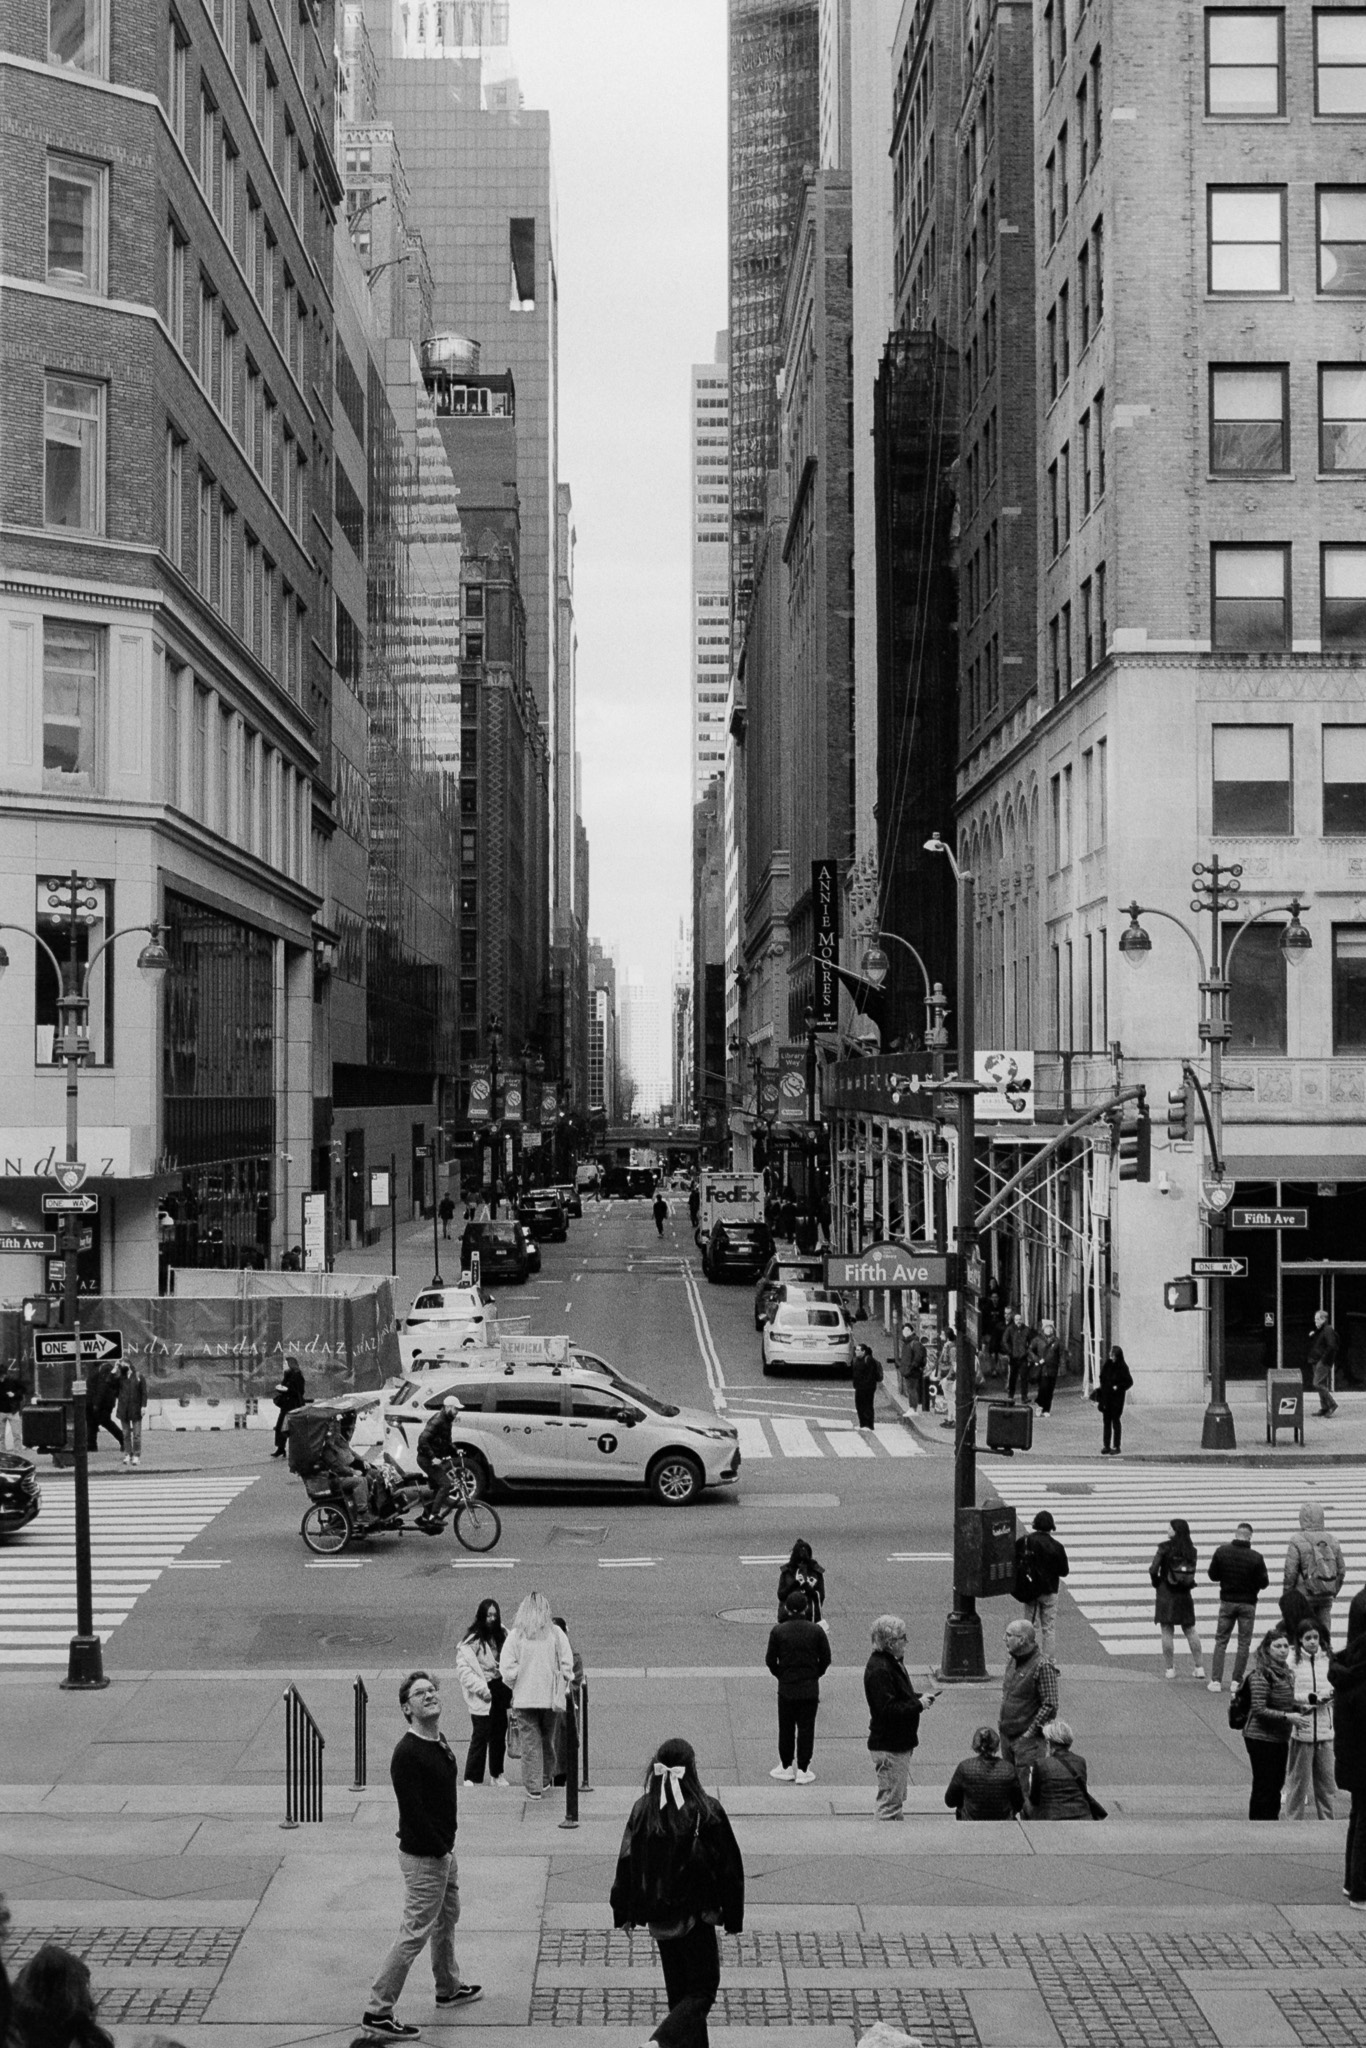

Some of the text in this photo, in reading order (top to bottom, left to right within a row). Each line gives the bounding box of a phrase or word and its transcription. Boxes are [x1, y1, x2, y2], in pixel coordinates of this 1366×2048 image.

[817, 865, 832, 928] ANNIE
[817, 931, 836, 1006] MOORES
[780, 1052, 805, 1061] Library
[785, 1059, 801, 1067] Way
[705, 1185, 761, 1204] FedEx
[47, 1199, 91, 1208] ONE WAY
[1244, 1213, 1296, 1224] Fifth Ave
[23, 1239, 44, 1249] Ave
[845, 1263, 929, 1281] Fifth Ave
[1199, 1262, 1239, 1271] ONE WAY
[44, 1339, 108, 1355] ONE WAY
